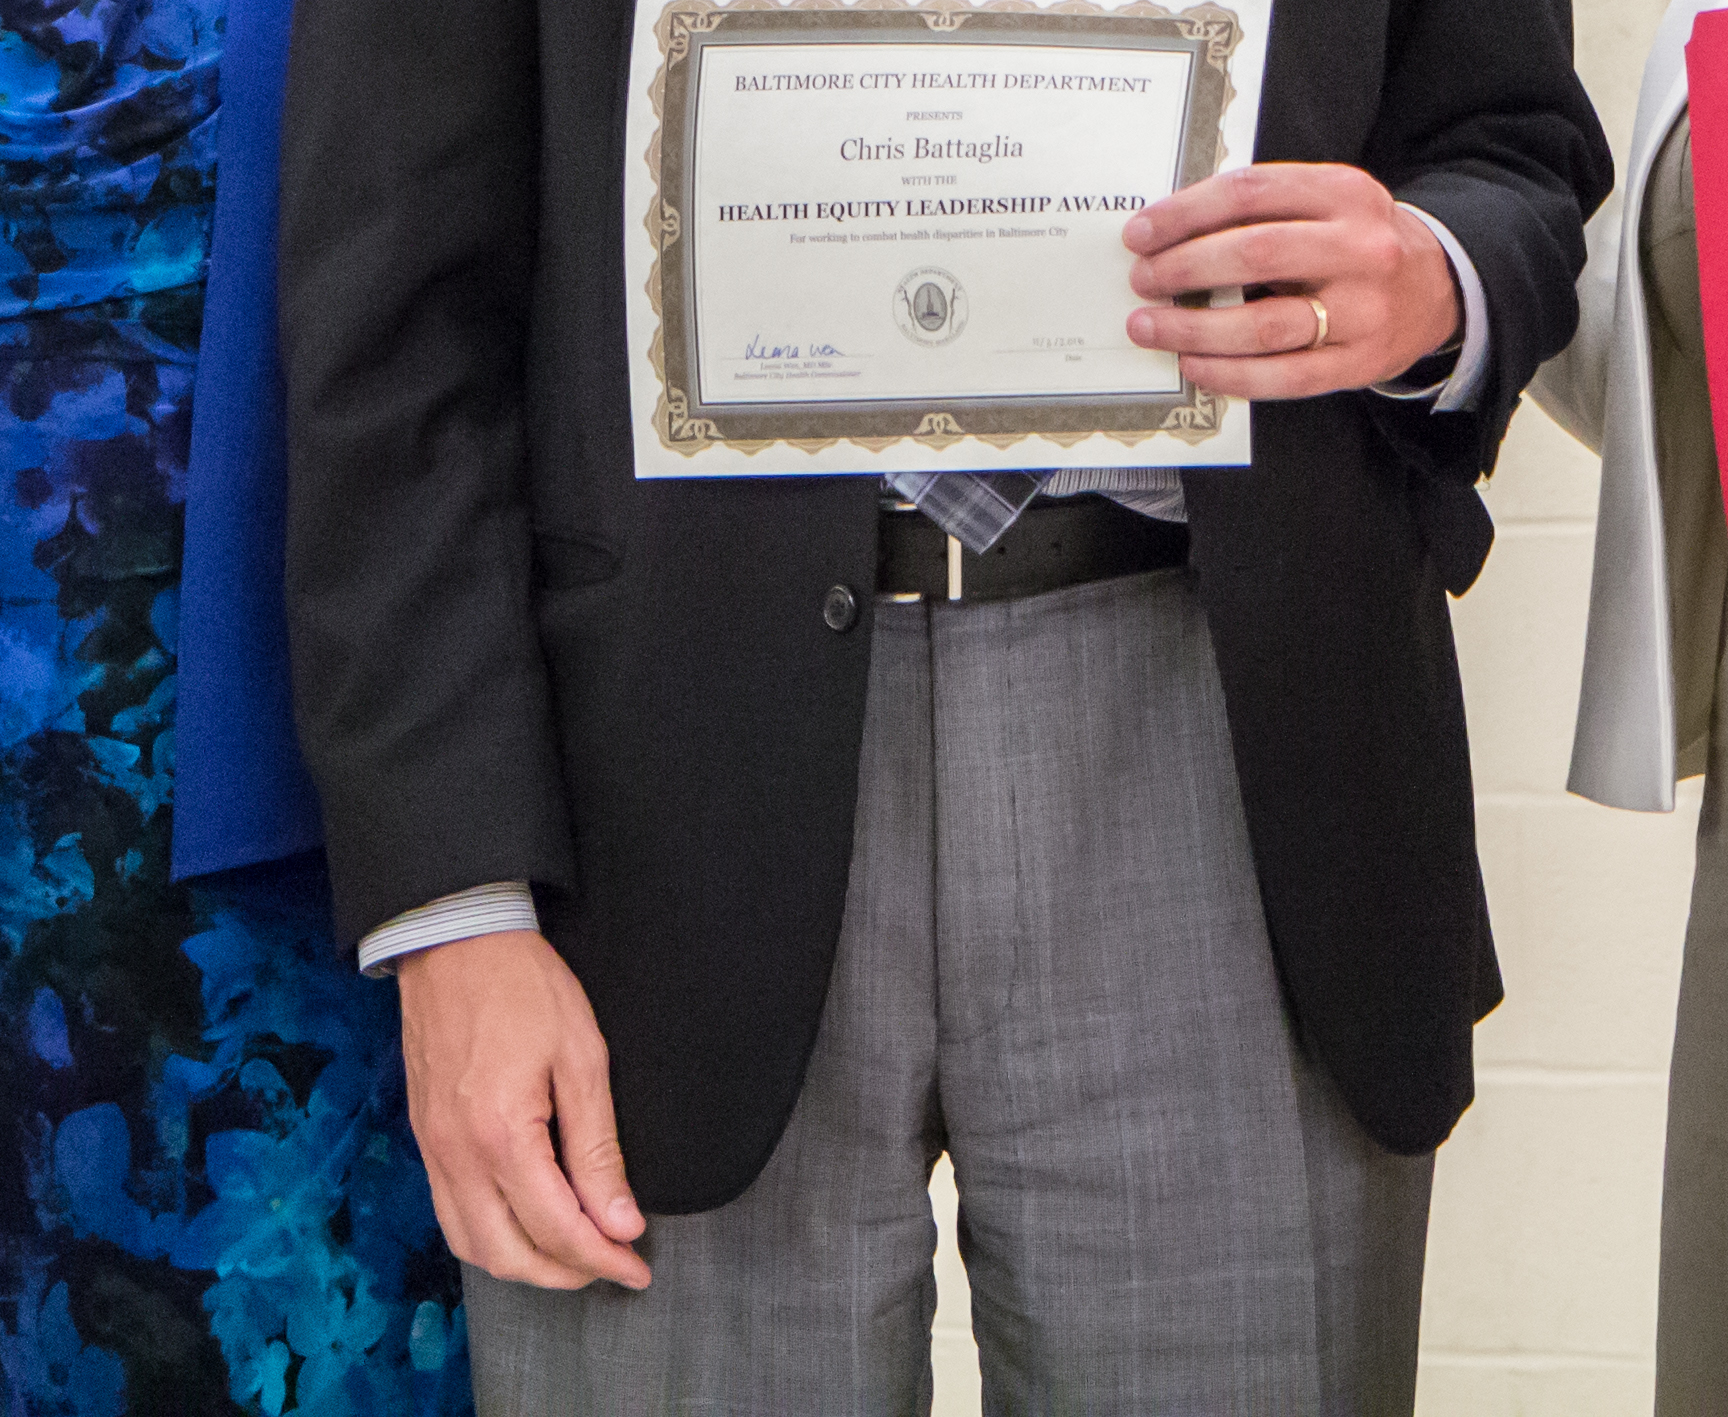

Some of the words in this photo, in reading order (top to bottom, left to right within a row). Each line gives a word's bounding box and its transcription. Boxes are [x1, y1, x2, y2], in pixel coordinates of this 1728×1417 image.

[734, 73, 854, 92] BALTIMORE
[859, 72, 906, 90] CITY
[911, 72, 996, 90] HEALTH
[1003, 73, 1152, 93] DEPARTMENT
[906, 111, 963, 121] PRESENTS
[840, 137, 905, 161] Chris
[913, 134, 1024, 164] Battaglia
[901, 175, 932, 186] WITH
[934, 175, 958, 185] THE
[718, 202, 809, 222] HEALTH
[816, 200, 899, 223] EQUITY
[905, 196, 1052, 217] LEADERSHIP
[1056, 195, 1146, 212] AWARD
[790, 233, 806, 244] For
[809, 232, 848, 244] working
[850, 233, 860, 243] to
[862, 231, 898, 242] combat
[900, 230, 931, 241] health
[932, 229, 983, 242] disparities
[985, 228, 996, 239] in
[998, 227, 1046, 239] Baltimore
[1048, 226, 1069, 238] City
